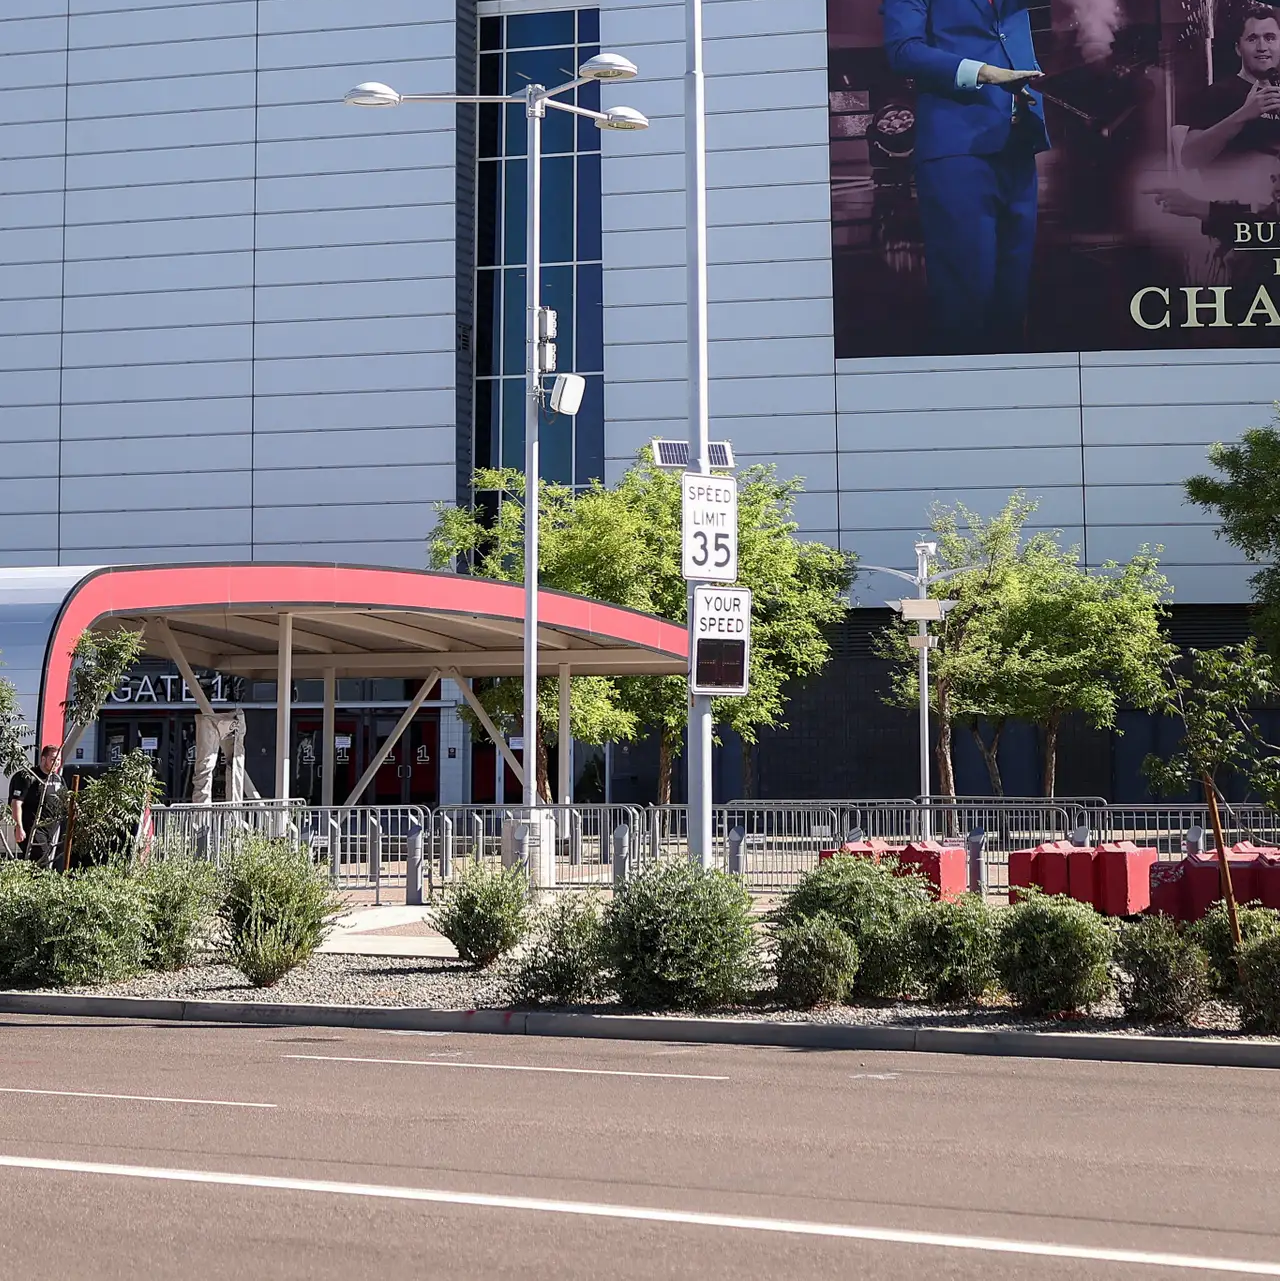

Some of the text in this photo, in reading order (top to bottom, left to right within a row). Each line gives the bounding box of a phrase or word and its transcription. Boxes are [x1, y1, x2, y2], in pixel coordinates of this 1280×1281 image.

[688, 485, 732, 504] SPEED
[693, 511, 727, 526] LIMIT
[691, 530, 731, 568] 35
[704, 596, 741, 613] YOUR
[699, 617, 744, 633] SPEED
[110, 674, 228, 702] GATE 1
[302, 744, 316, 762] 1
[336, 746, 350, 762] 1
[416, 744, 430, 762] 1
